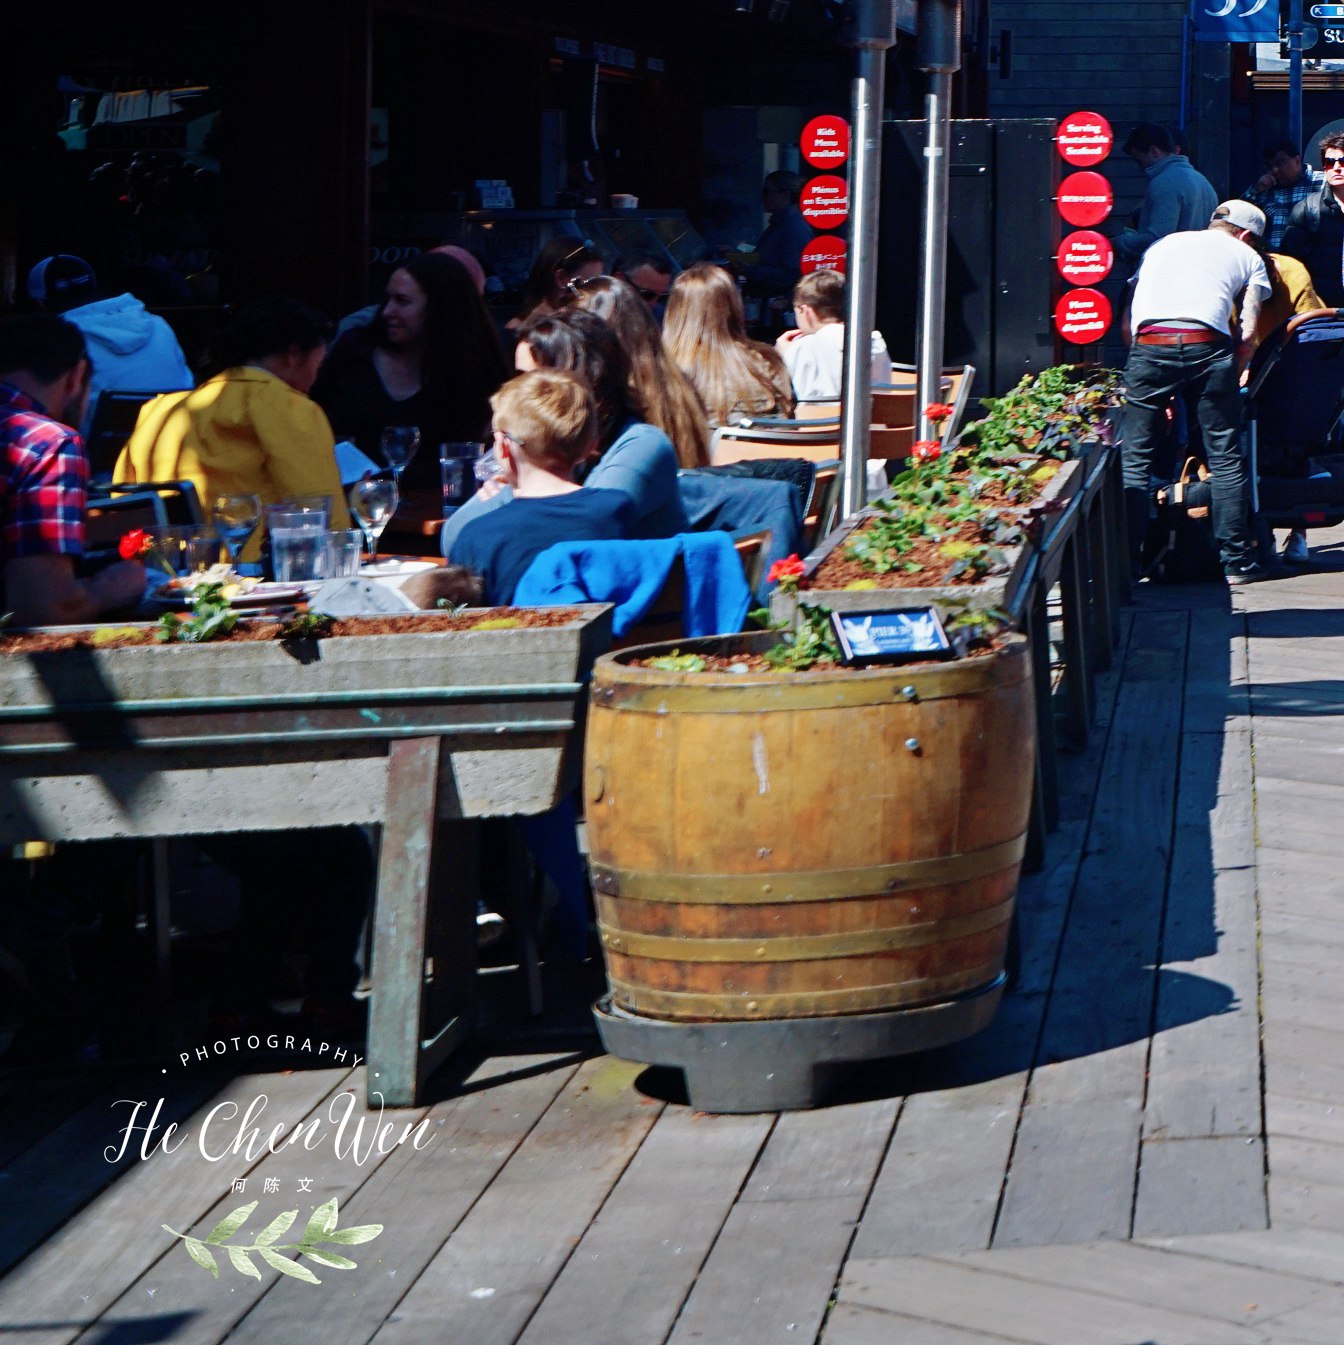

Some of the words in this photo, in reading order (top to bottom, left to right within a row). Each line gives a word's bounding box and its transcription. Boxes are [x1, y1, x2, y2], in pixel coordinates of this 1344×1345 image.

[1066, 124, 1102, 135] Serving
[814, 139, 839, 147] Menu
[1059, 135, 1109, 144] Sustainable
[809, 150, 846, 158] available
[1065, 146, 1102, 155] Seafood
